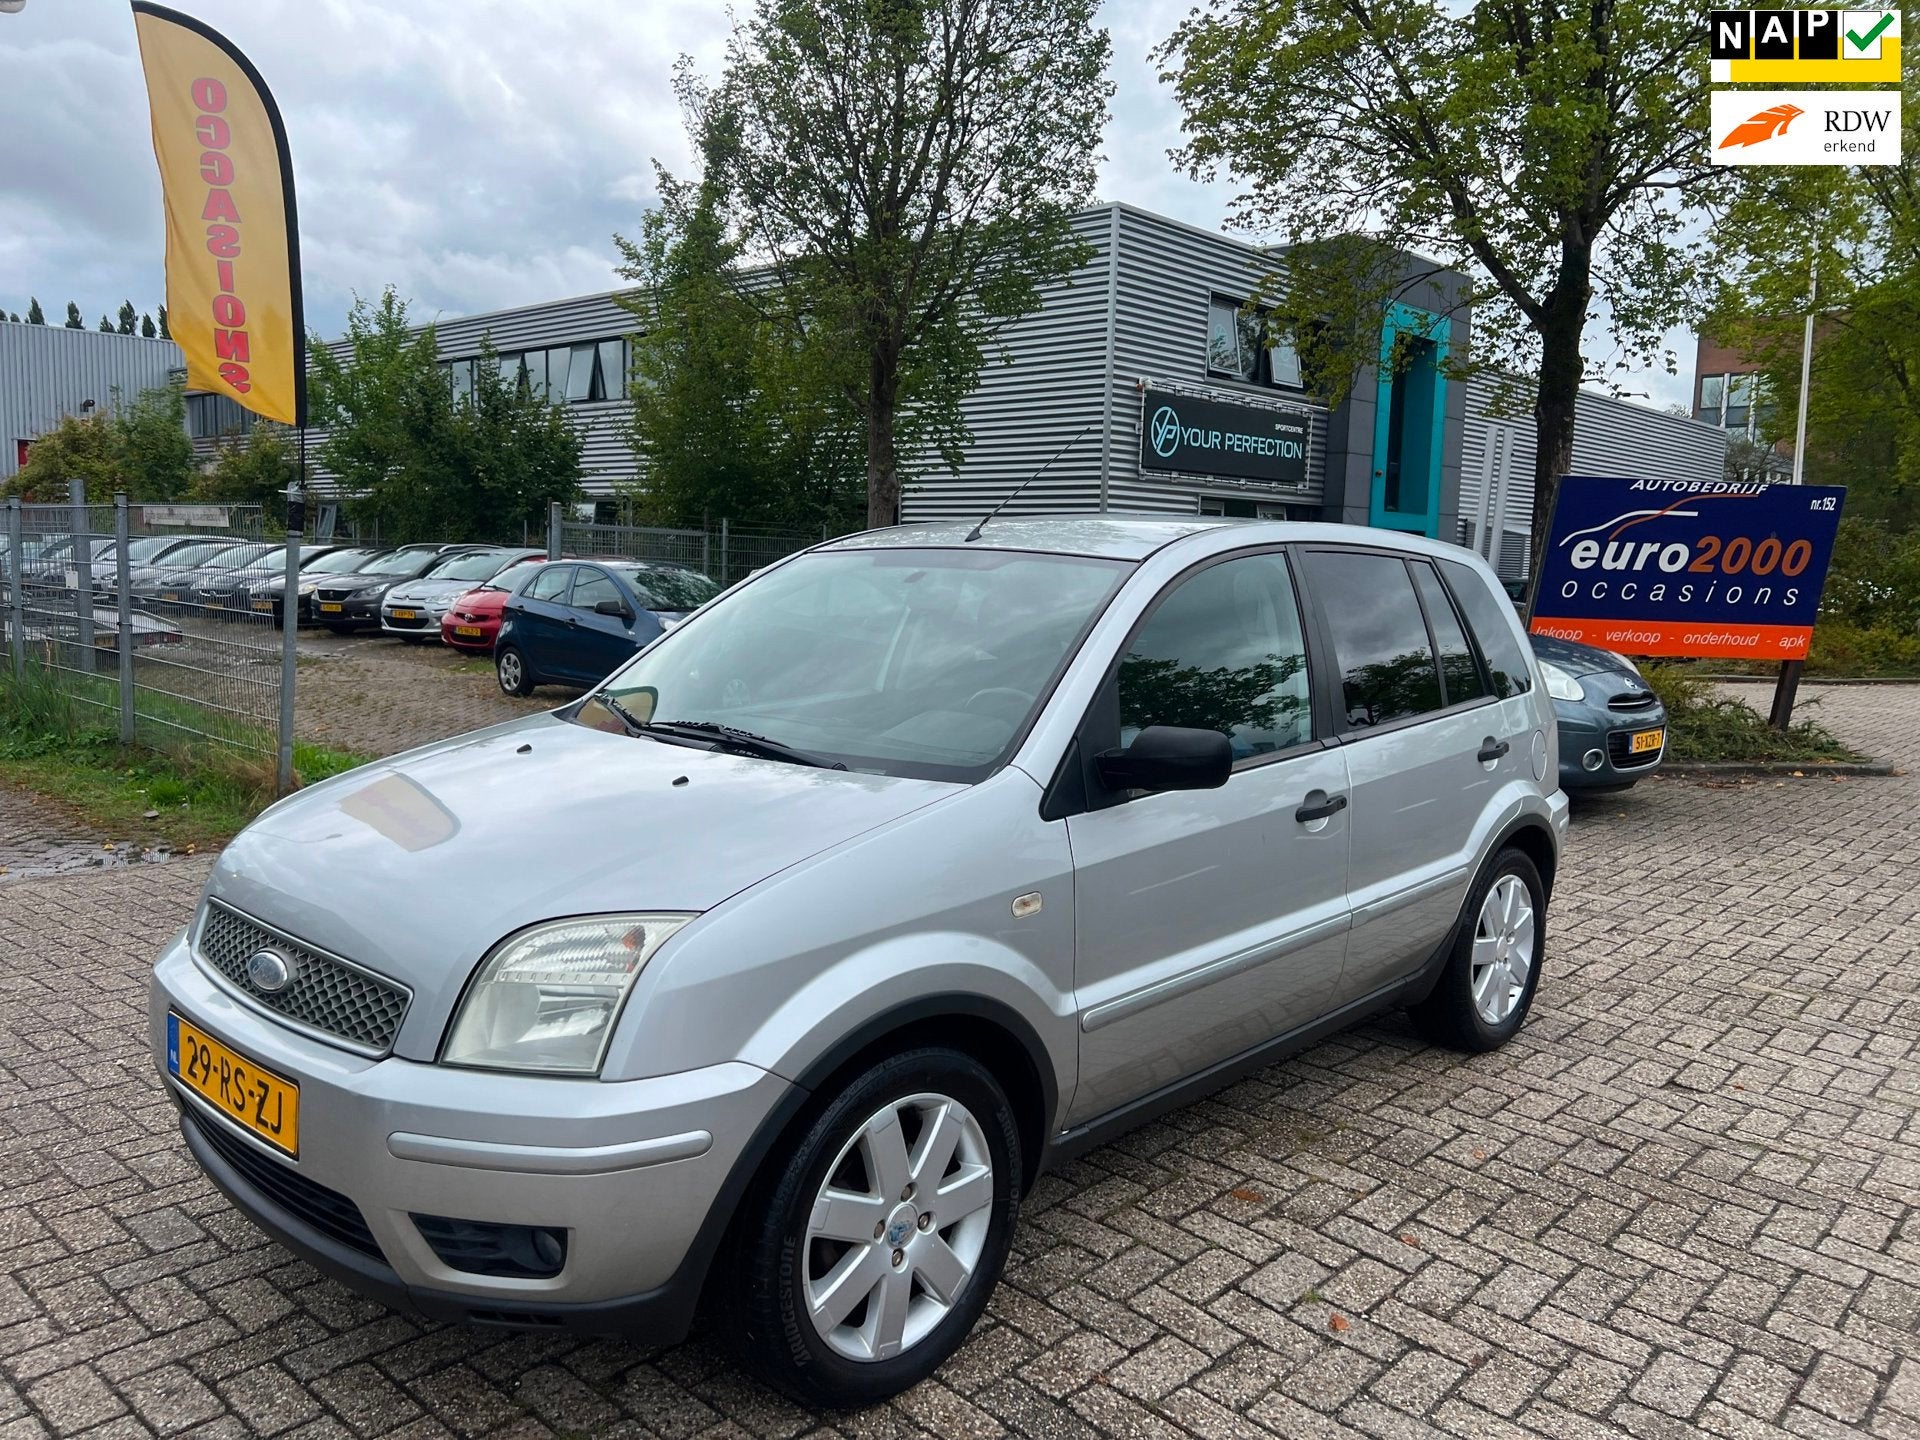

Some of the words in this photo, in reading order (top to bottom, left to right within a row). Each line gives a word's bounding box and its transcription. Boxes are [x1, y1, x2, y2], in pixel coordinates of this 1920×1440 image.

[1274, 423, 1304, 434] SPORTCENTRE
[1181, 427, 1221, 450] YOUR
[1225, 433, 1303, 460] PERFECTION
[1629, 479, 1769, 496] AUTOBEDRIJF
[1809, 497, 1837, 512] nr.152
[1569, 535, 1813, 578] euro2000
[1561, 579, 1800, 606] occasions
[1605, 630, 1661, 645] verkoop
[1683, 632, 1761, 647] onderhoud
[1778, 635, 1805, 649] apk
[187, 1035, 283, 1135] 29-RS-ZJ
